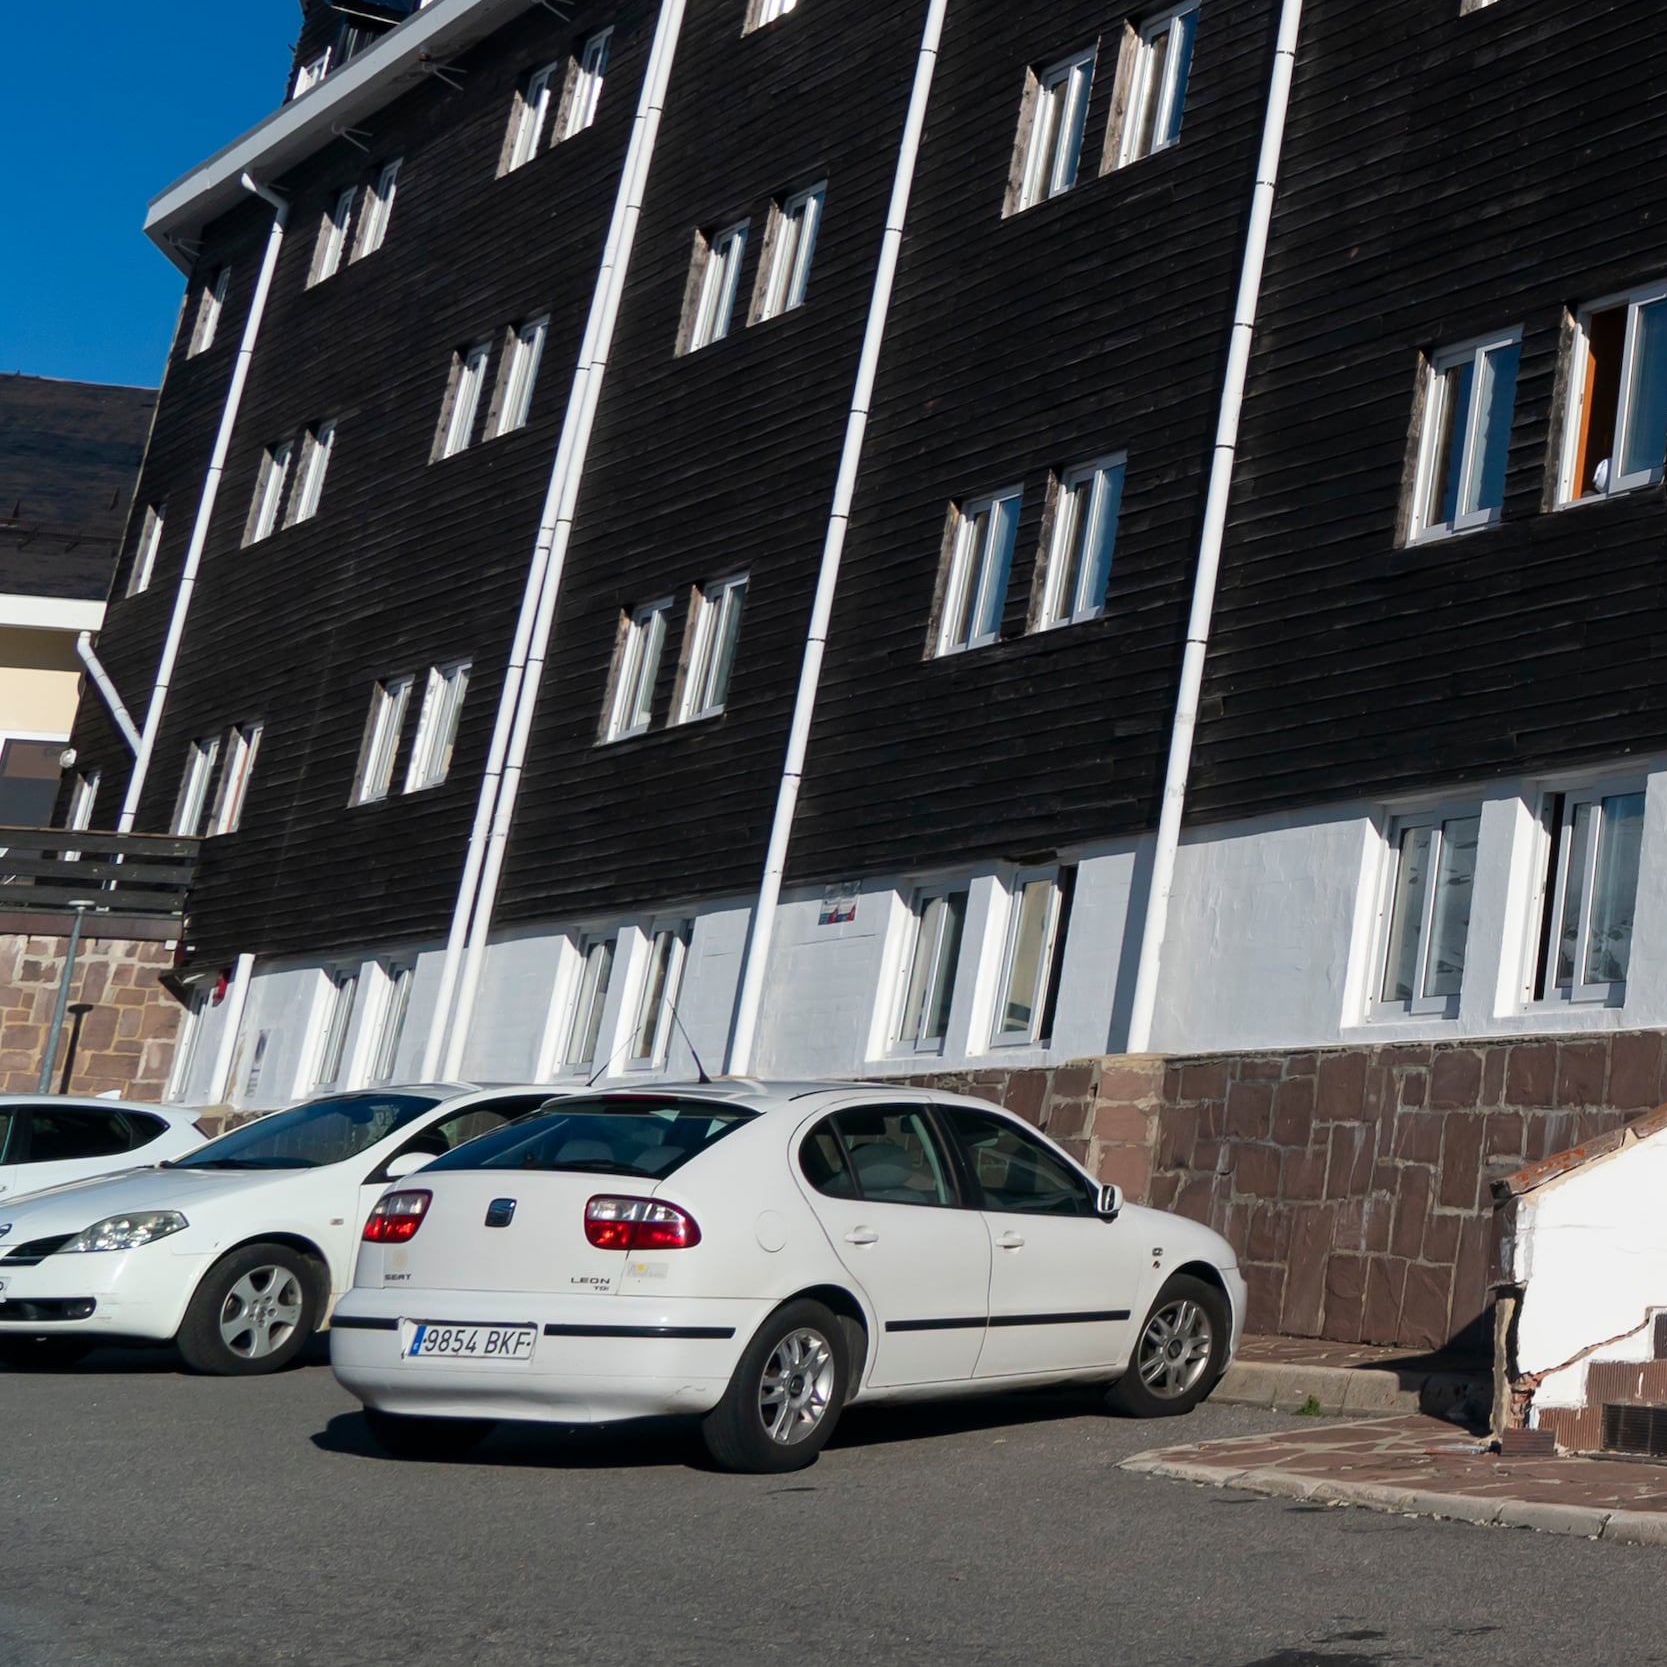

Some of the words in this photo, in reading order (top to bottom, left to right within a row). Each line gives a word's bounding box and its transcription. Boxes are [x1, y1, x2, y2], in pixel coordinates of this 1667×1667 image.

[571, 1277, 611, 1285] LEON
[425, 1329, 478, 1353] 9854
[484, 1330, 531, 1354] BKF
